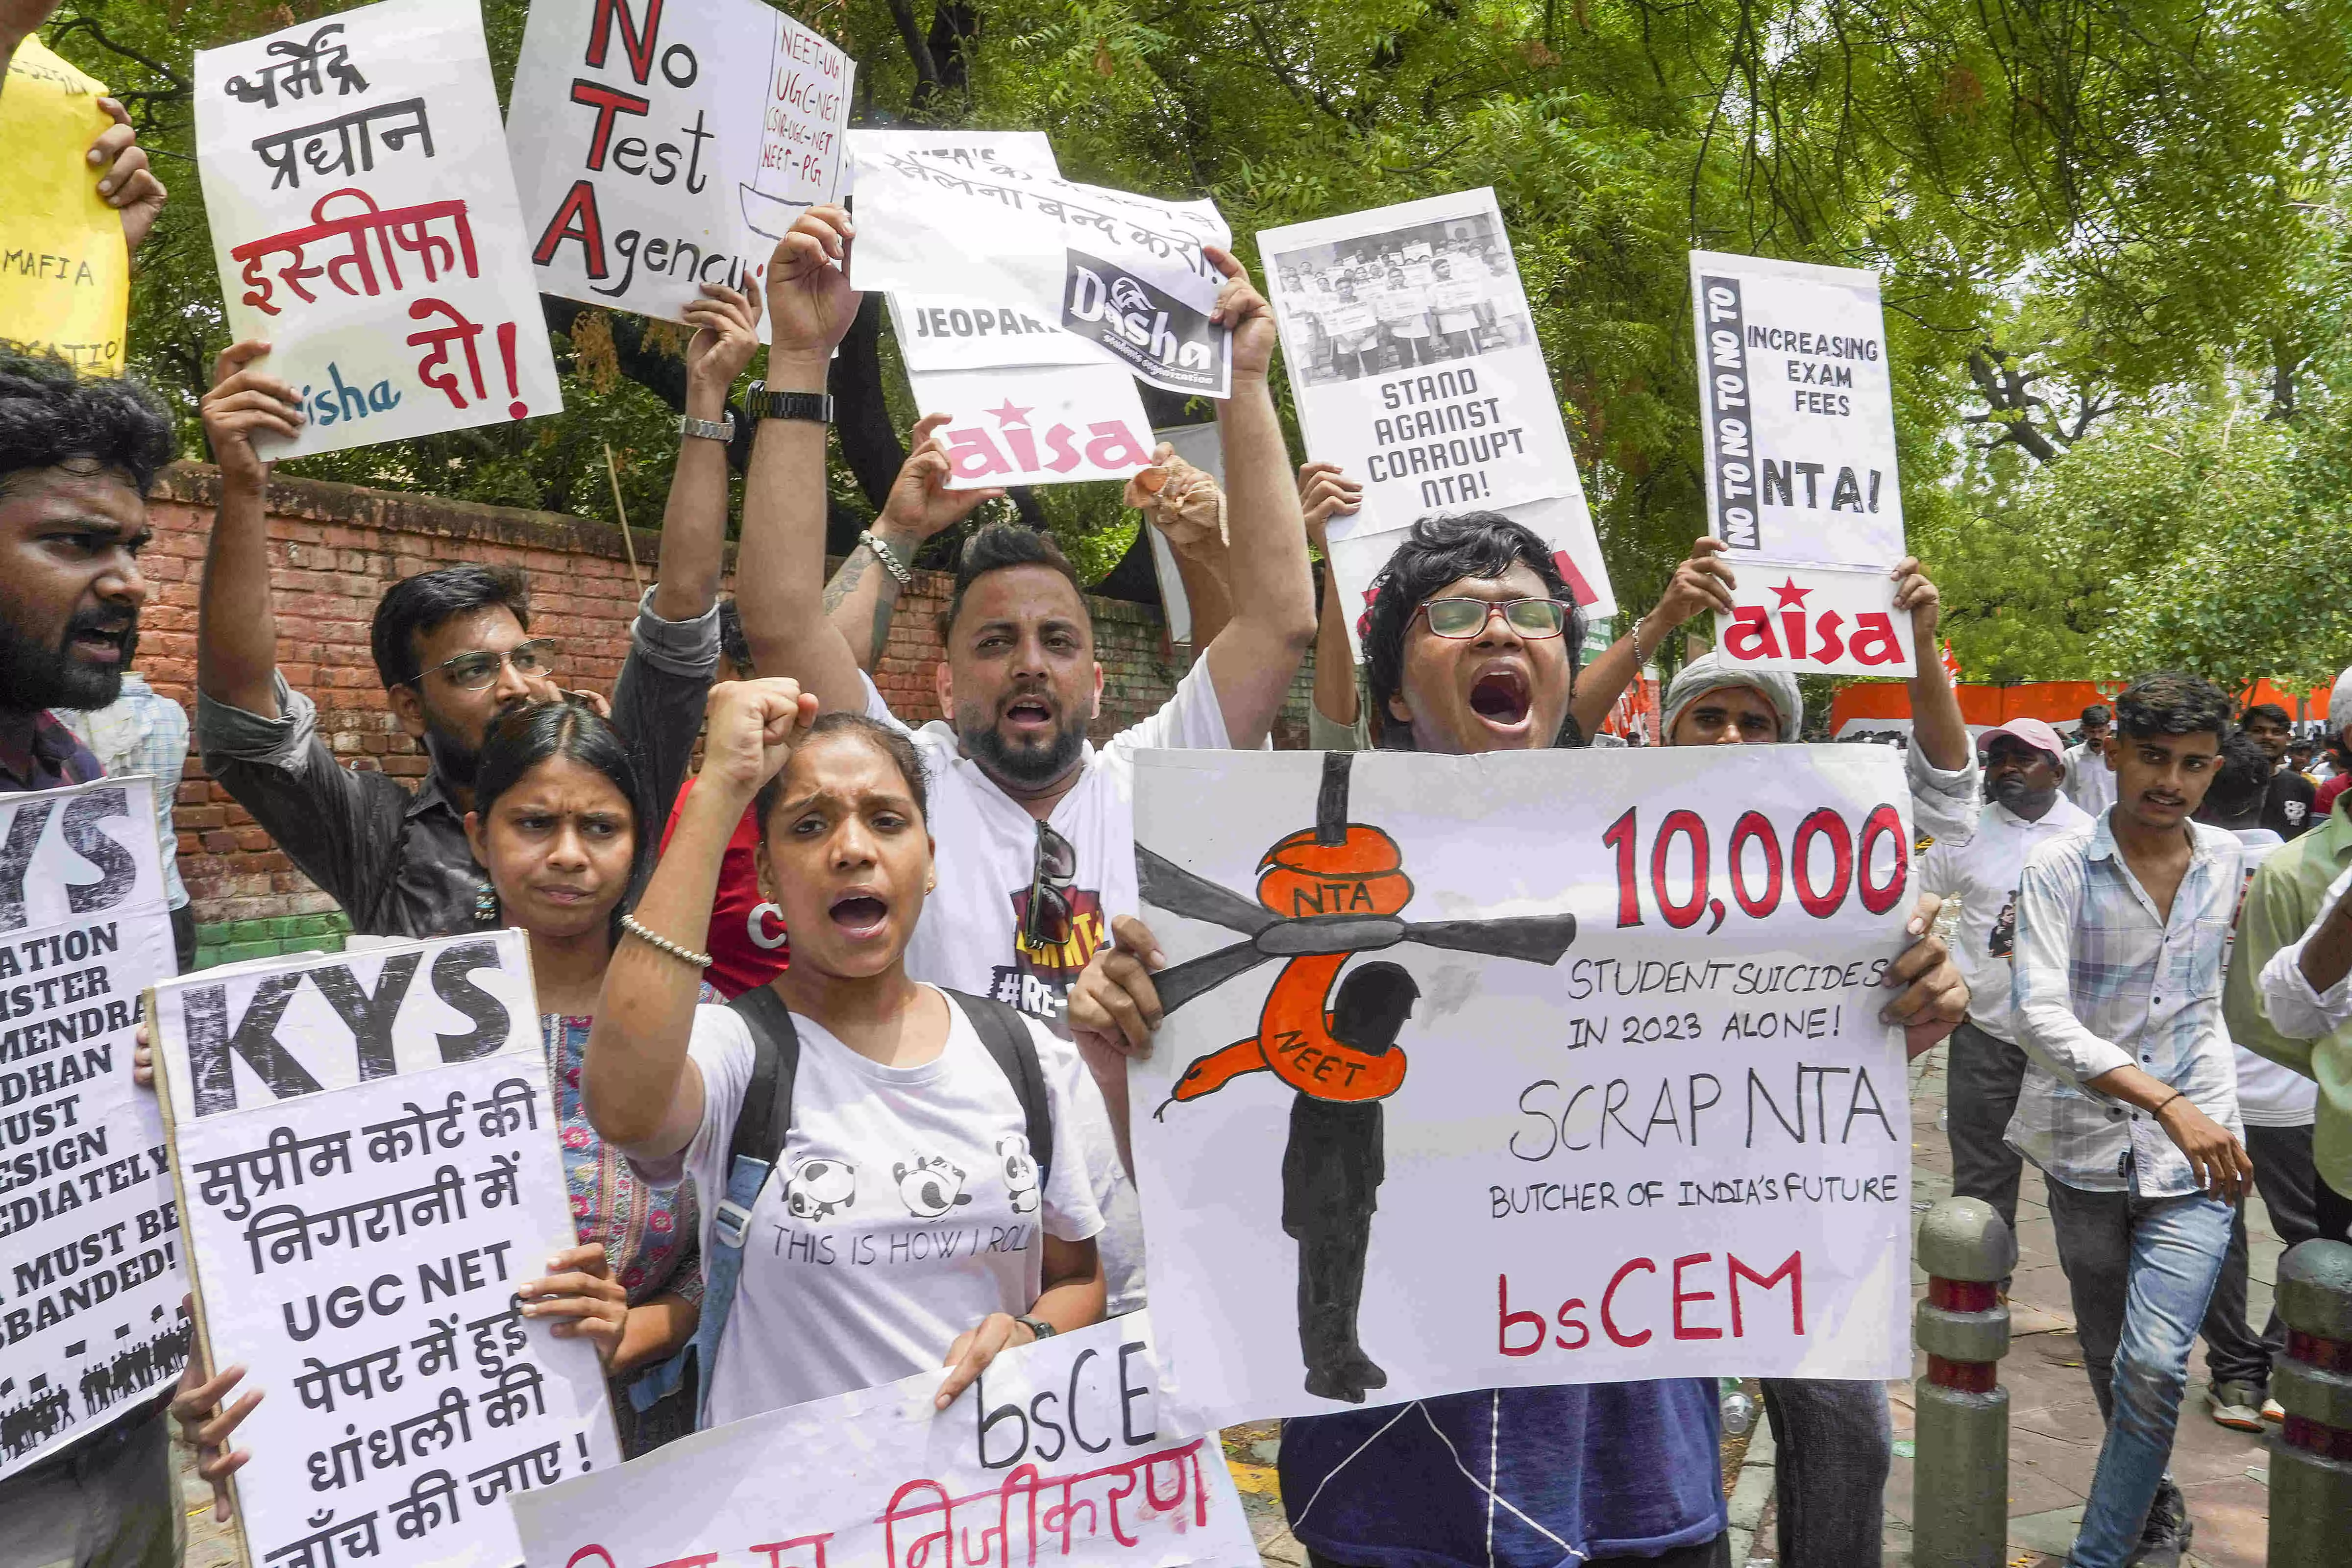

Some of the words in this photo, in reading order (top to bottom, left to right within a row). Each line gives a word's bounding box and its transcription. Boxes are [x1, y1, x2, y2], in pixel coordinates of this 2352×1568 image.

[586, 0, 697, 88] No
[782, 25, 839, 79] NEET-UG
[777, 67, 839, 122] UGC-NET
[252, 98, 435, 189] प्रधान
[570, 78, 714, 194] Test
[3, 249, 94, 286] MAFIA
[230, 188, 479, 315] इस्तीफा
[917, 308, 1062, 338] JEOPAR
[1708, 287, 1737, 322] TO
[407, 298, 528, 420] दो!
[1711, 330, 1741, 368] NO
[1748, 324, 1878, 362] INCREASING
[295, 362, 401, 425] isha
[1381, 368, 1478, 410] STAND
[1716, 374, 1745, 410] TO
[1788, 360, 1852, 389] EXAM
[1795, 390, 1850, 416] FEES
[945, 417, 1152, 479] aisa
[1374, 398, 1503, 445] AGAINST
[1719, 418, 1748, 457] NO
[1368, 428, 1525, 483] CORROUPT
[1723, 462, 1752, 499] TO
[1422, 470, 1491, 508] NTA!
[1764, 459, 1881, 514] NTA!
[1725, 507, 1755, 546] NO
[1724, 603, 1905, 665] aisa
[1602, 803, 1908, 935] 10,000
[1293, 882, 1374, 916] NTA
[181, 940, 510, 1117] KYS
[1568, 1017, 1607, 1049] IN
[1623, 1012, 1702, 1044] 2023
[1722, 1005, 1841, 1042] ALONE!
[0, 1043, 112, 1106] DHAN
[1274, 1030, 1366, 1087] NEET
[0, 1095, 79, 1152] UST
[1509, 1073, 1722, 1161] SCRAP
[1746, 1061, 1897, 1148] NTA
[193, 1127, 352, 1221] सुप्रीम
[362, 1091, 466, 1163] कोर्ट
[472, 1078, 537, 1137] की
[244, 1164, 466, 1274] निगरानी
[474, 1150, 520, 1209] में
[1489, 1181, 1619, 1218] BUTCHER
[1628, 1180, 1665, 1206] OF
[1678, 1176, 1778, 1207] INDIA'S
[1785, 1173, 1898, 1202] FUTURE
[13, 1221, 127, 1297] MUST
[773, 1225, 836, 1265] THIS
[851, 1234, 876, 1266] IS
[890, 1231, 963, 1264] HOW
[971, 1228, 979, 1256] I
[0, 1241, 178, 1351] BANDED!
[284, 1274, 405, 1342] UGC
[417, 1241, 511, 1304] NET
[1499, 1250, 1804, 1357] bsCEM
[294, 1356, 403, 1414] पेपर
[412, 1313, 459, 1375] में
[307, 1386, 470, 1492] धांधली
[480, 1363, 545, 1428] की
[389, 1469, 461, 1541] की
[468, 1441, 562, 1506] जाए
